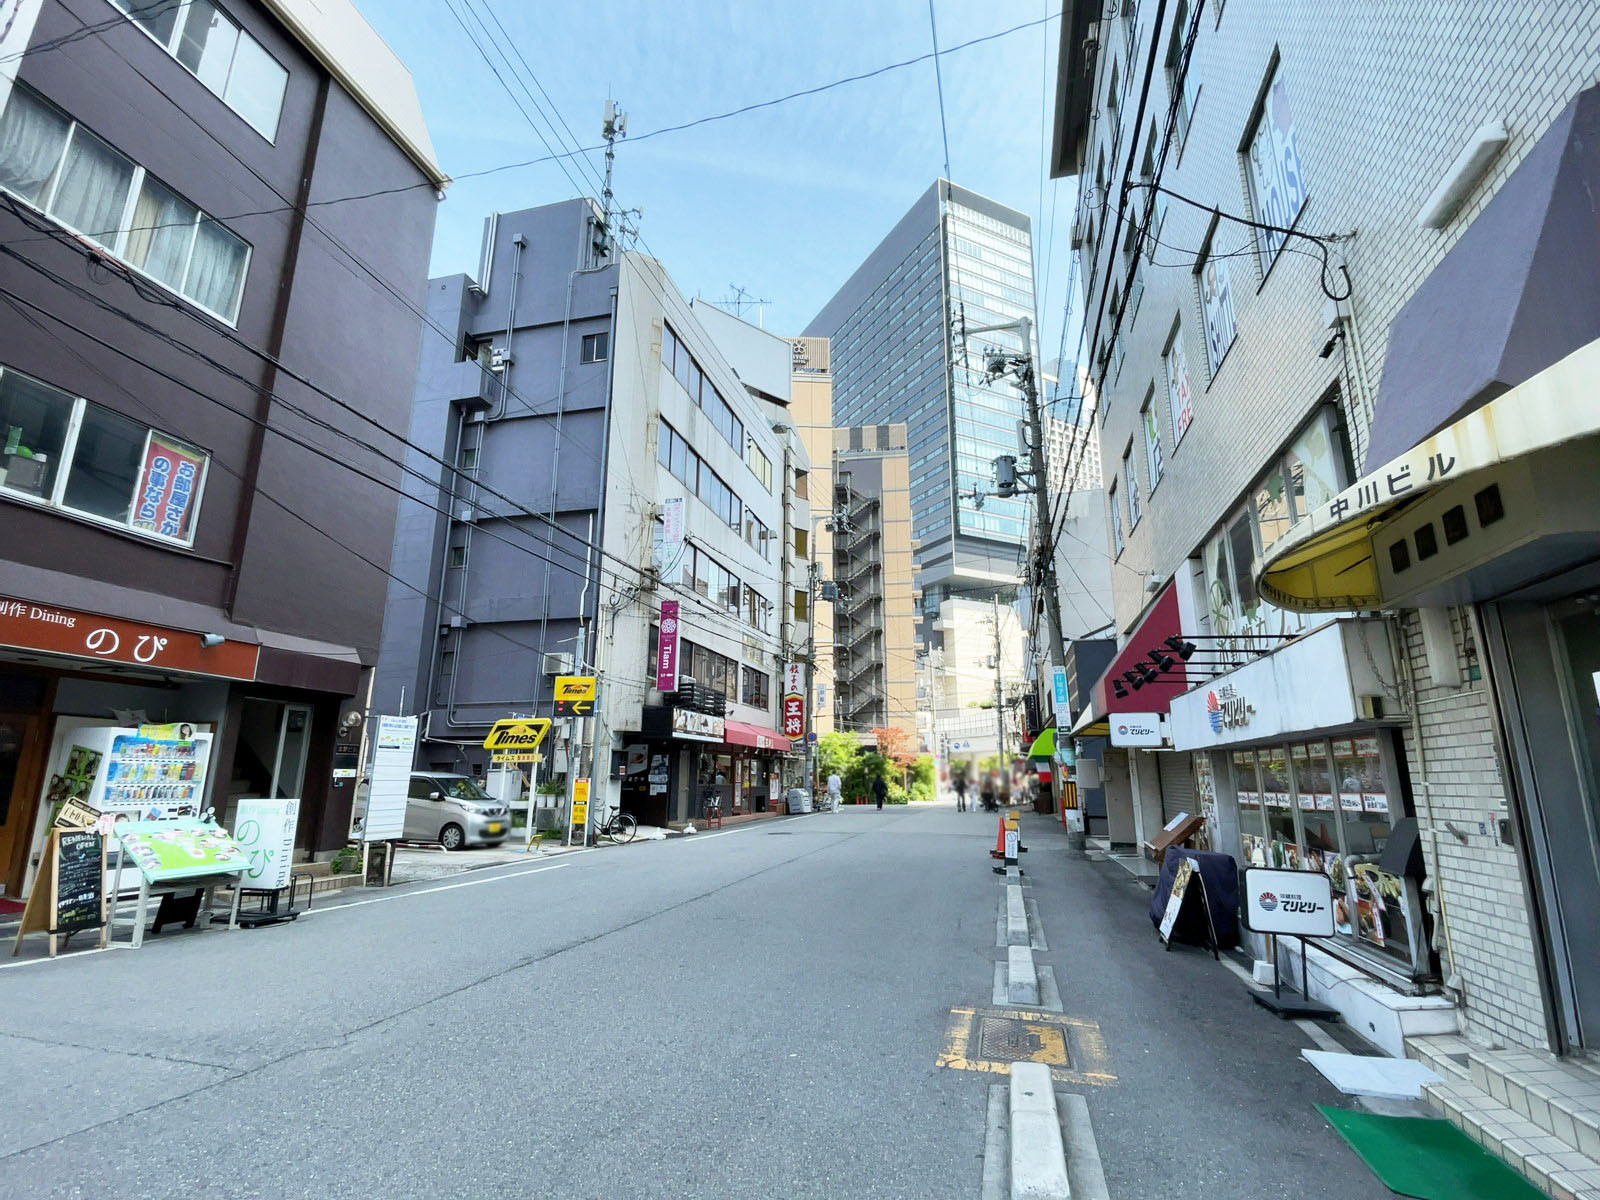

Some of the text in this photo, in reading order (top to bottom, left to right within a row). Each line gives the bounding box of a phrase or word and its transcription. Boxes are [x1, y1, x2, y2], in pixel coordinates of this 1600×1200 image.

[1330, 452, 1455, 520] 中川ビル
[30, 607, 76, 628] Dining
[86, 628, 168, 662] のぴ
[562, 684, 591, 694] Times
[786, 701, 802, 734] 王将
[493, 727, 542, 746] Times
[76, 840, 96, 851] OPEN
